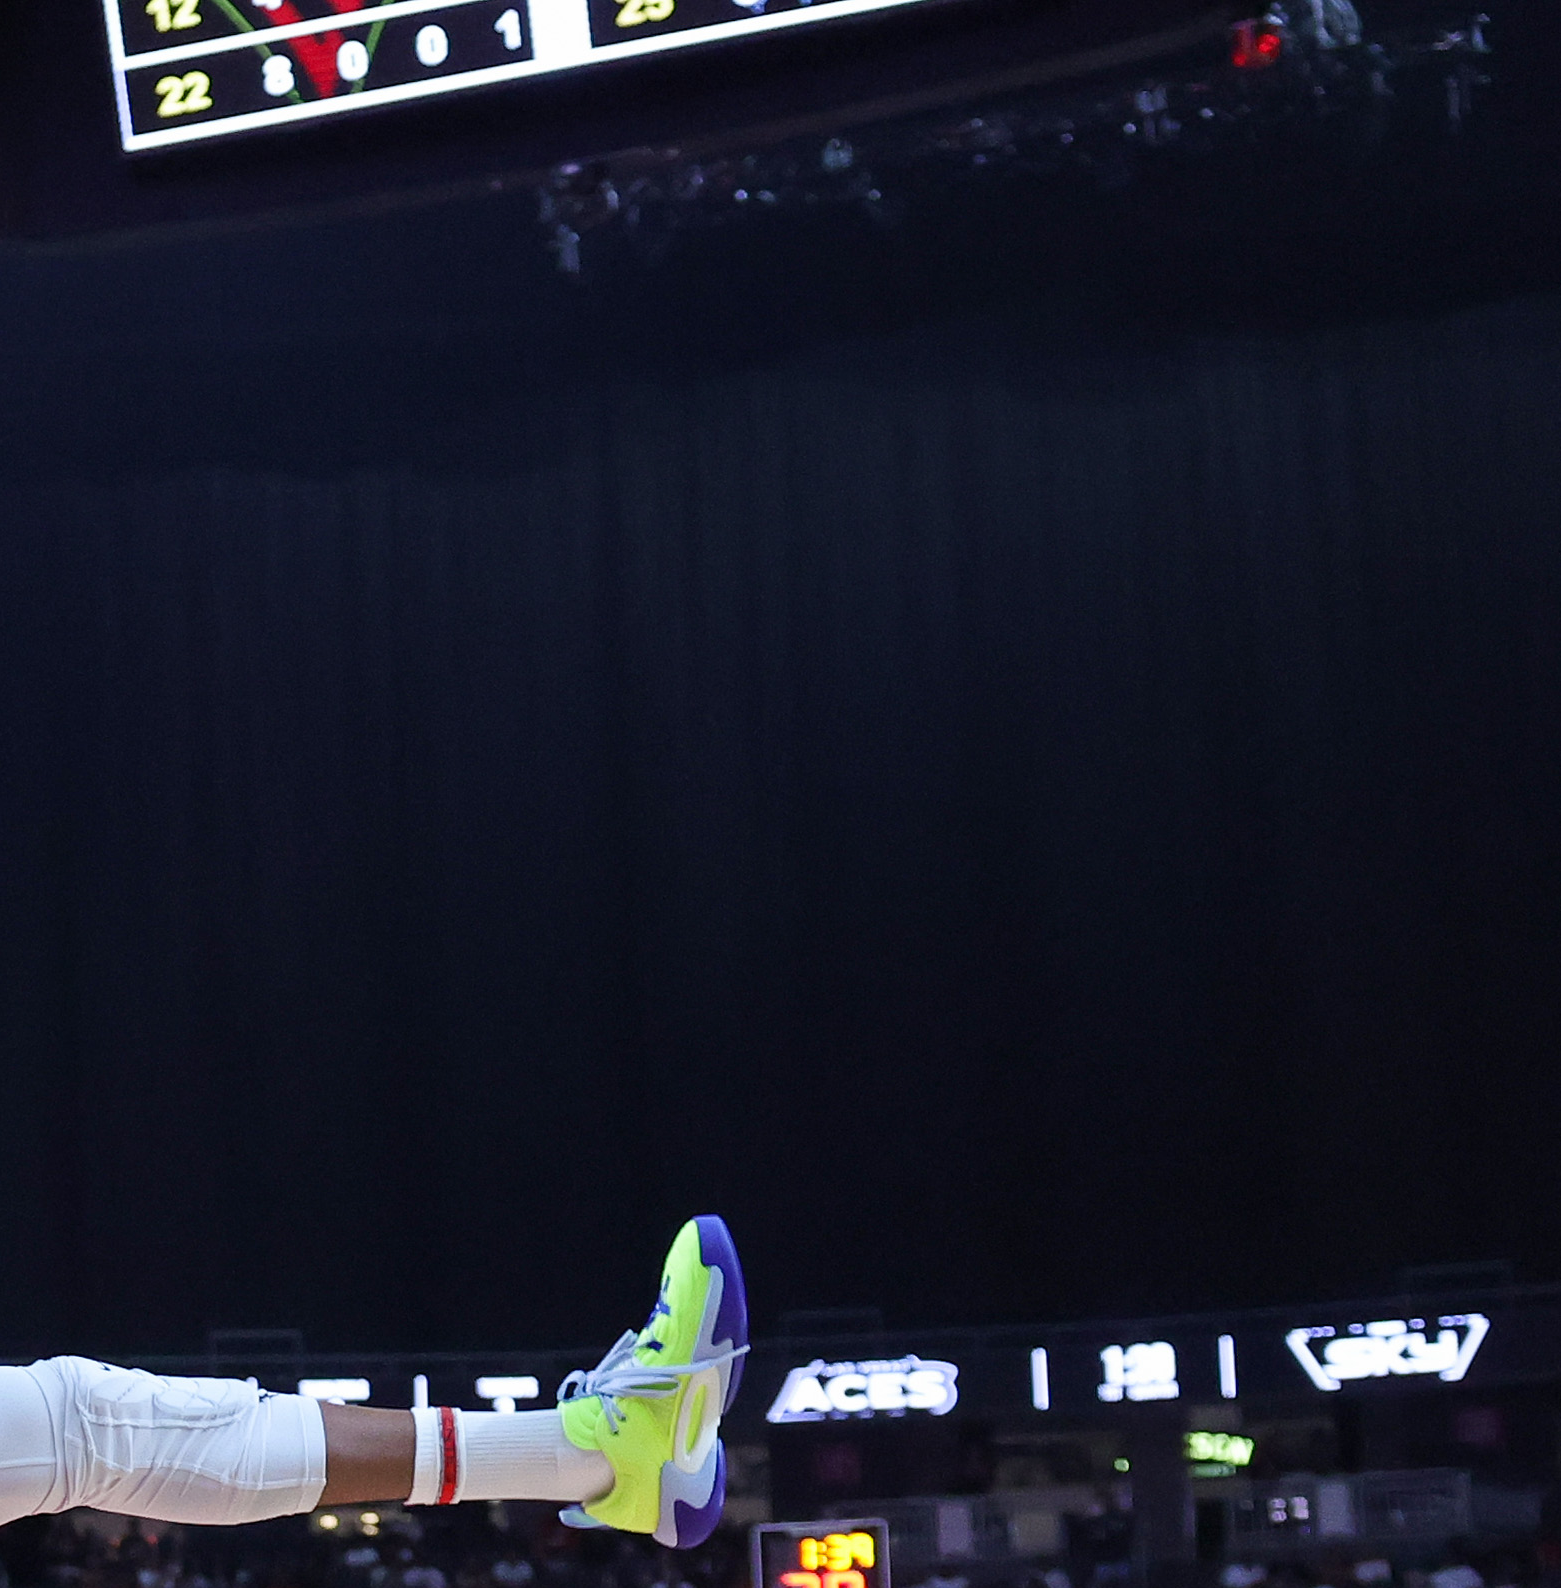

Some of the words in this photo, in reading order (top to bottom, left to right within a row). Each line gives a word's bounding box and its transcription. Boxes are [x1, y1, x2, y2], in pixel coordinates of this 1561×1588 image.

[154, 70, 214, 118] 22
[336, 40, 370, 82] 0
[414, 24, 450, 67] 0
[493, 8, 525, 51] 1
[787, 1369, 949, 1413] ACES
[1322, 1330, 1460, 1379] SKY
